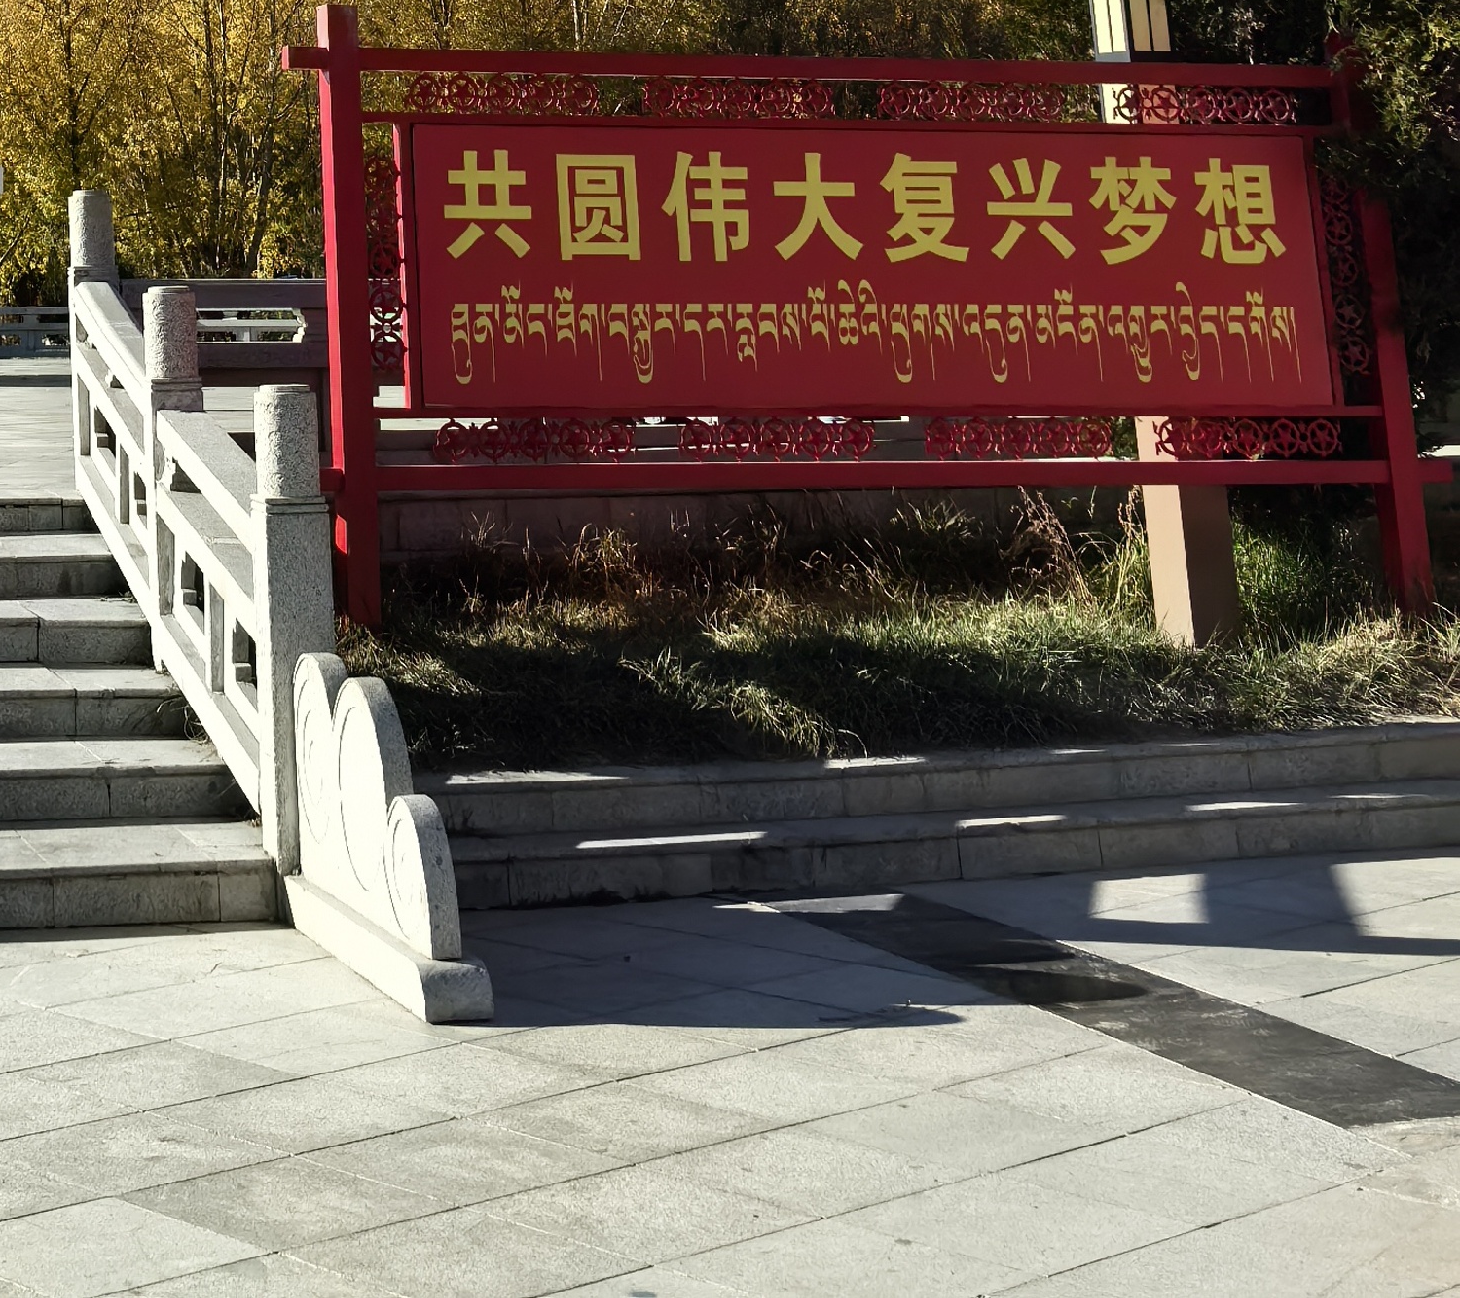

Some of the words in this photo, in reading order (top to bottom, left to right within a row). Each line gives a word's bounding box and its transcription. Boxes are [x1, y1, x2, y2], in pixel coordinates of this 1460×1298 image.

[444, 149, 1286, 265] 共圆伟大复兴梦想
